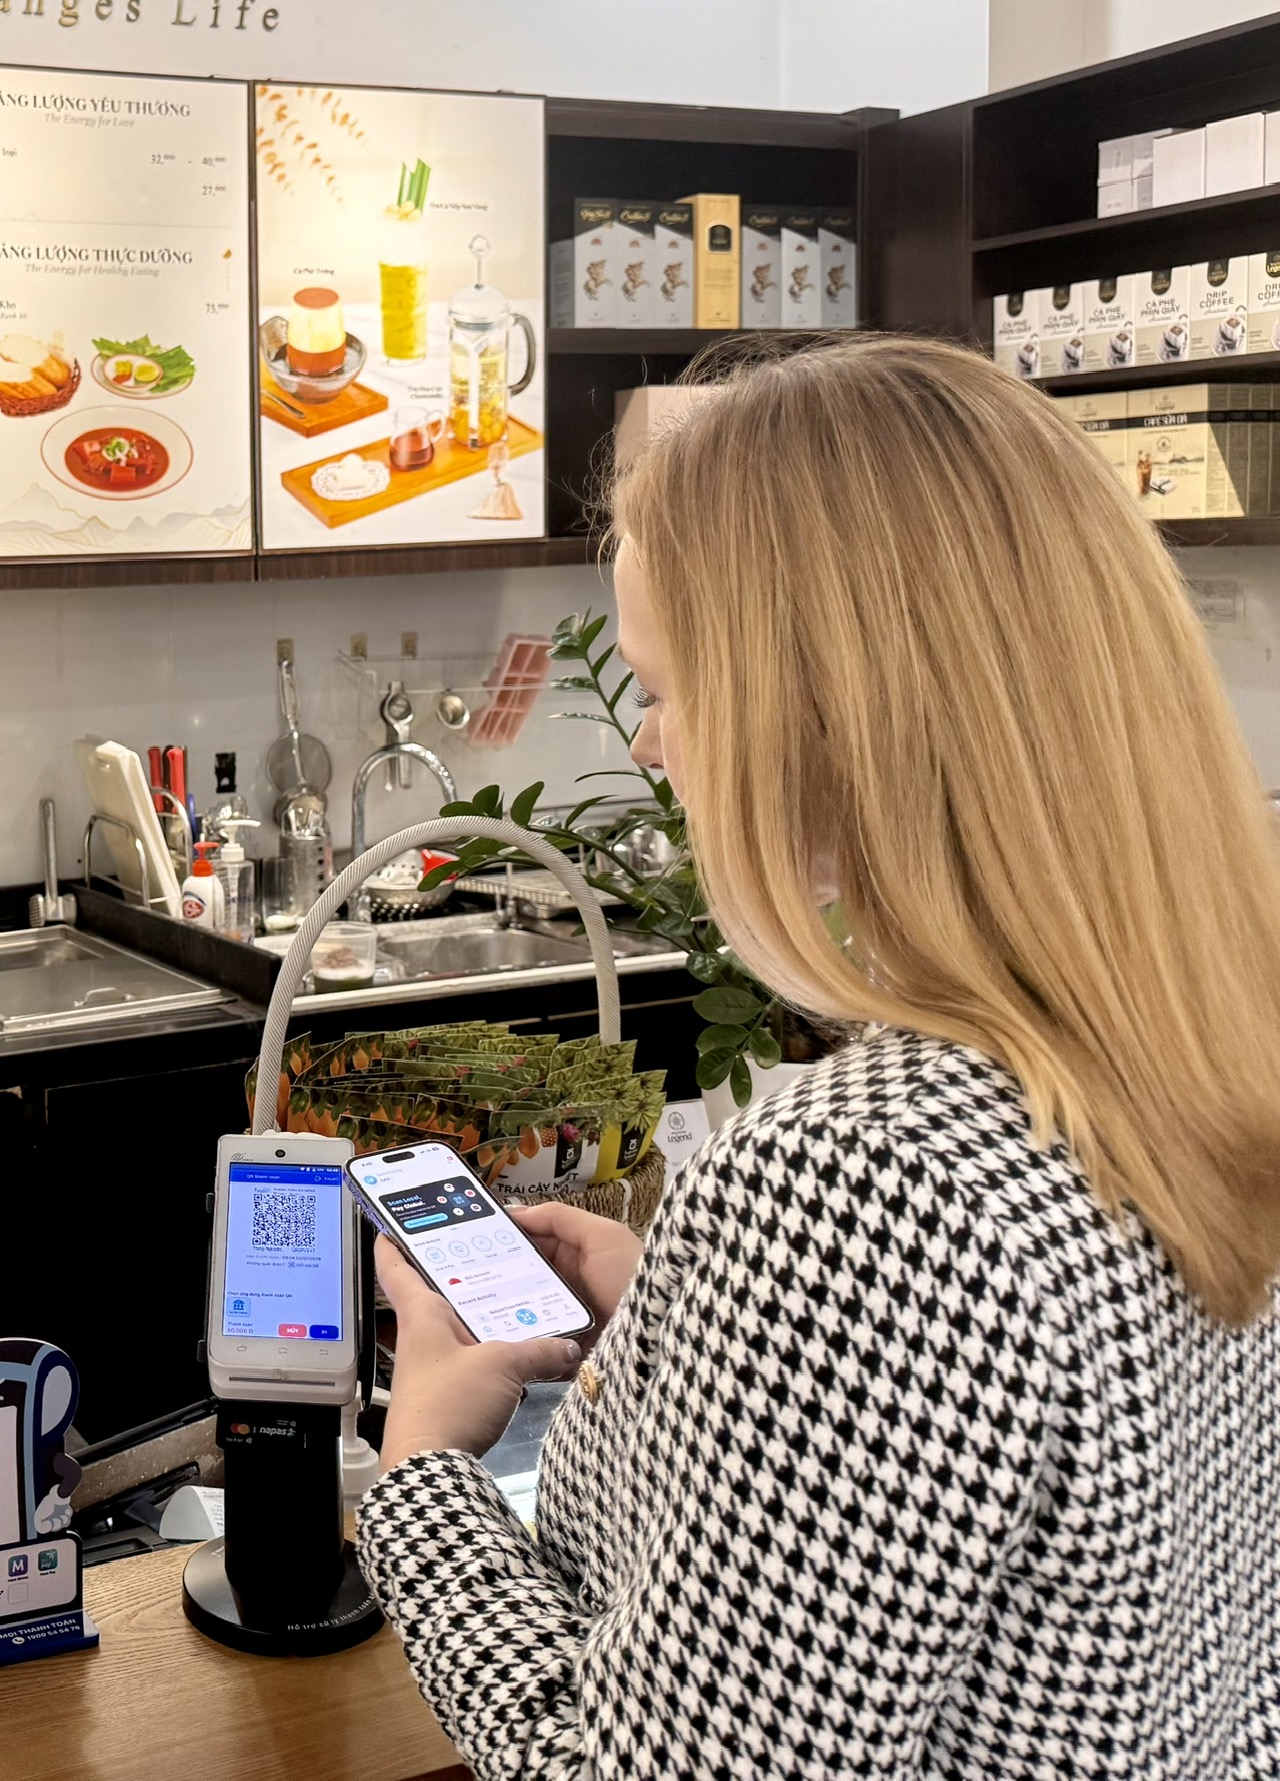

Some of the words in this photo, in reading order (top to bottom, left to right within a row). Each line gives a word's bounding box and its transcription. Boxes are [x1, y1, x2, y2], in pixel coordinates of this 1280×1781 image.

[171, 0, 279, 32] Life
[44, 112, 62, 123] The
[64, 114, 96, 127] Energy
[97, 116, 111, 128] for
[112, 117, 135, 127] Love
[25, 263, 42, 273] The
[44, 264, 77, 276] Energy
[77, 264, 91, 276] for
[93, 266, 129, 277] Healthy
[130, 266, 160, 278] Eating
[1199, 296, 1233, 308] COFFEE
[1206, 291, 1227, 301] DRIP
[667, 1132, 692, 1143] Legend
[496, 1183, 524, 1193] TRÁI
[529, 1182, 551, 1199] CÂY
[390, 1204, 404, 1214] Pay
[403, 1200, 427, 1210] Global.
[457, 1297, 478, 1306] Recent
[476, 1292, 497, 1301] Activity
[259, 1426, 288, 1436] napas
[17, 1625, 50, 1635] THANH
[50, 1618, 76, 1628] TOÁN
